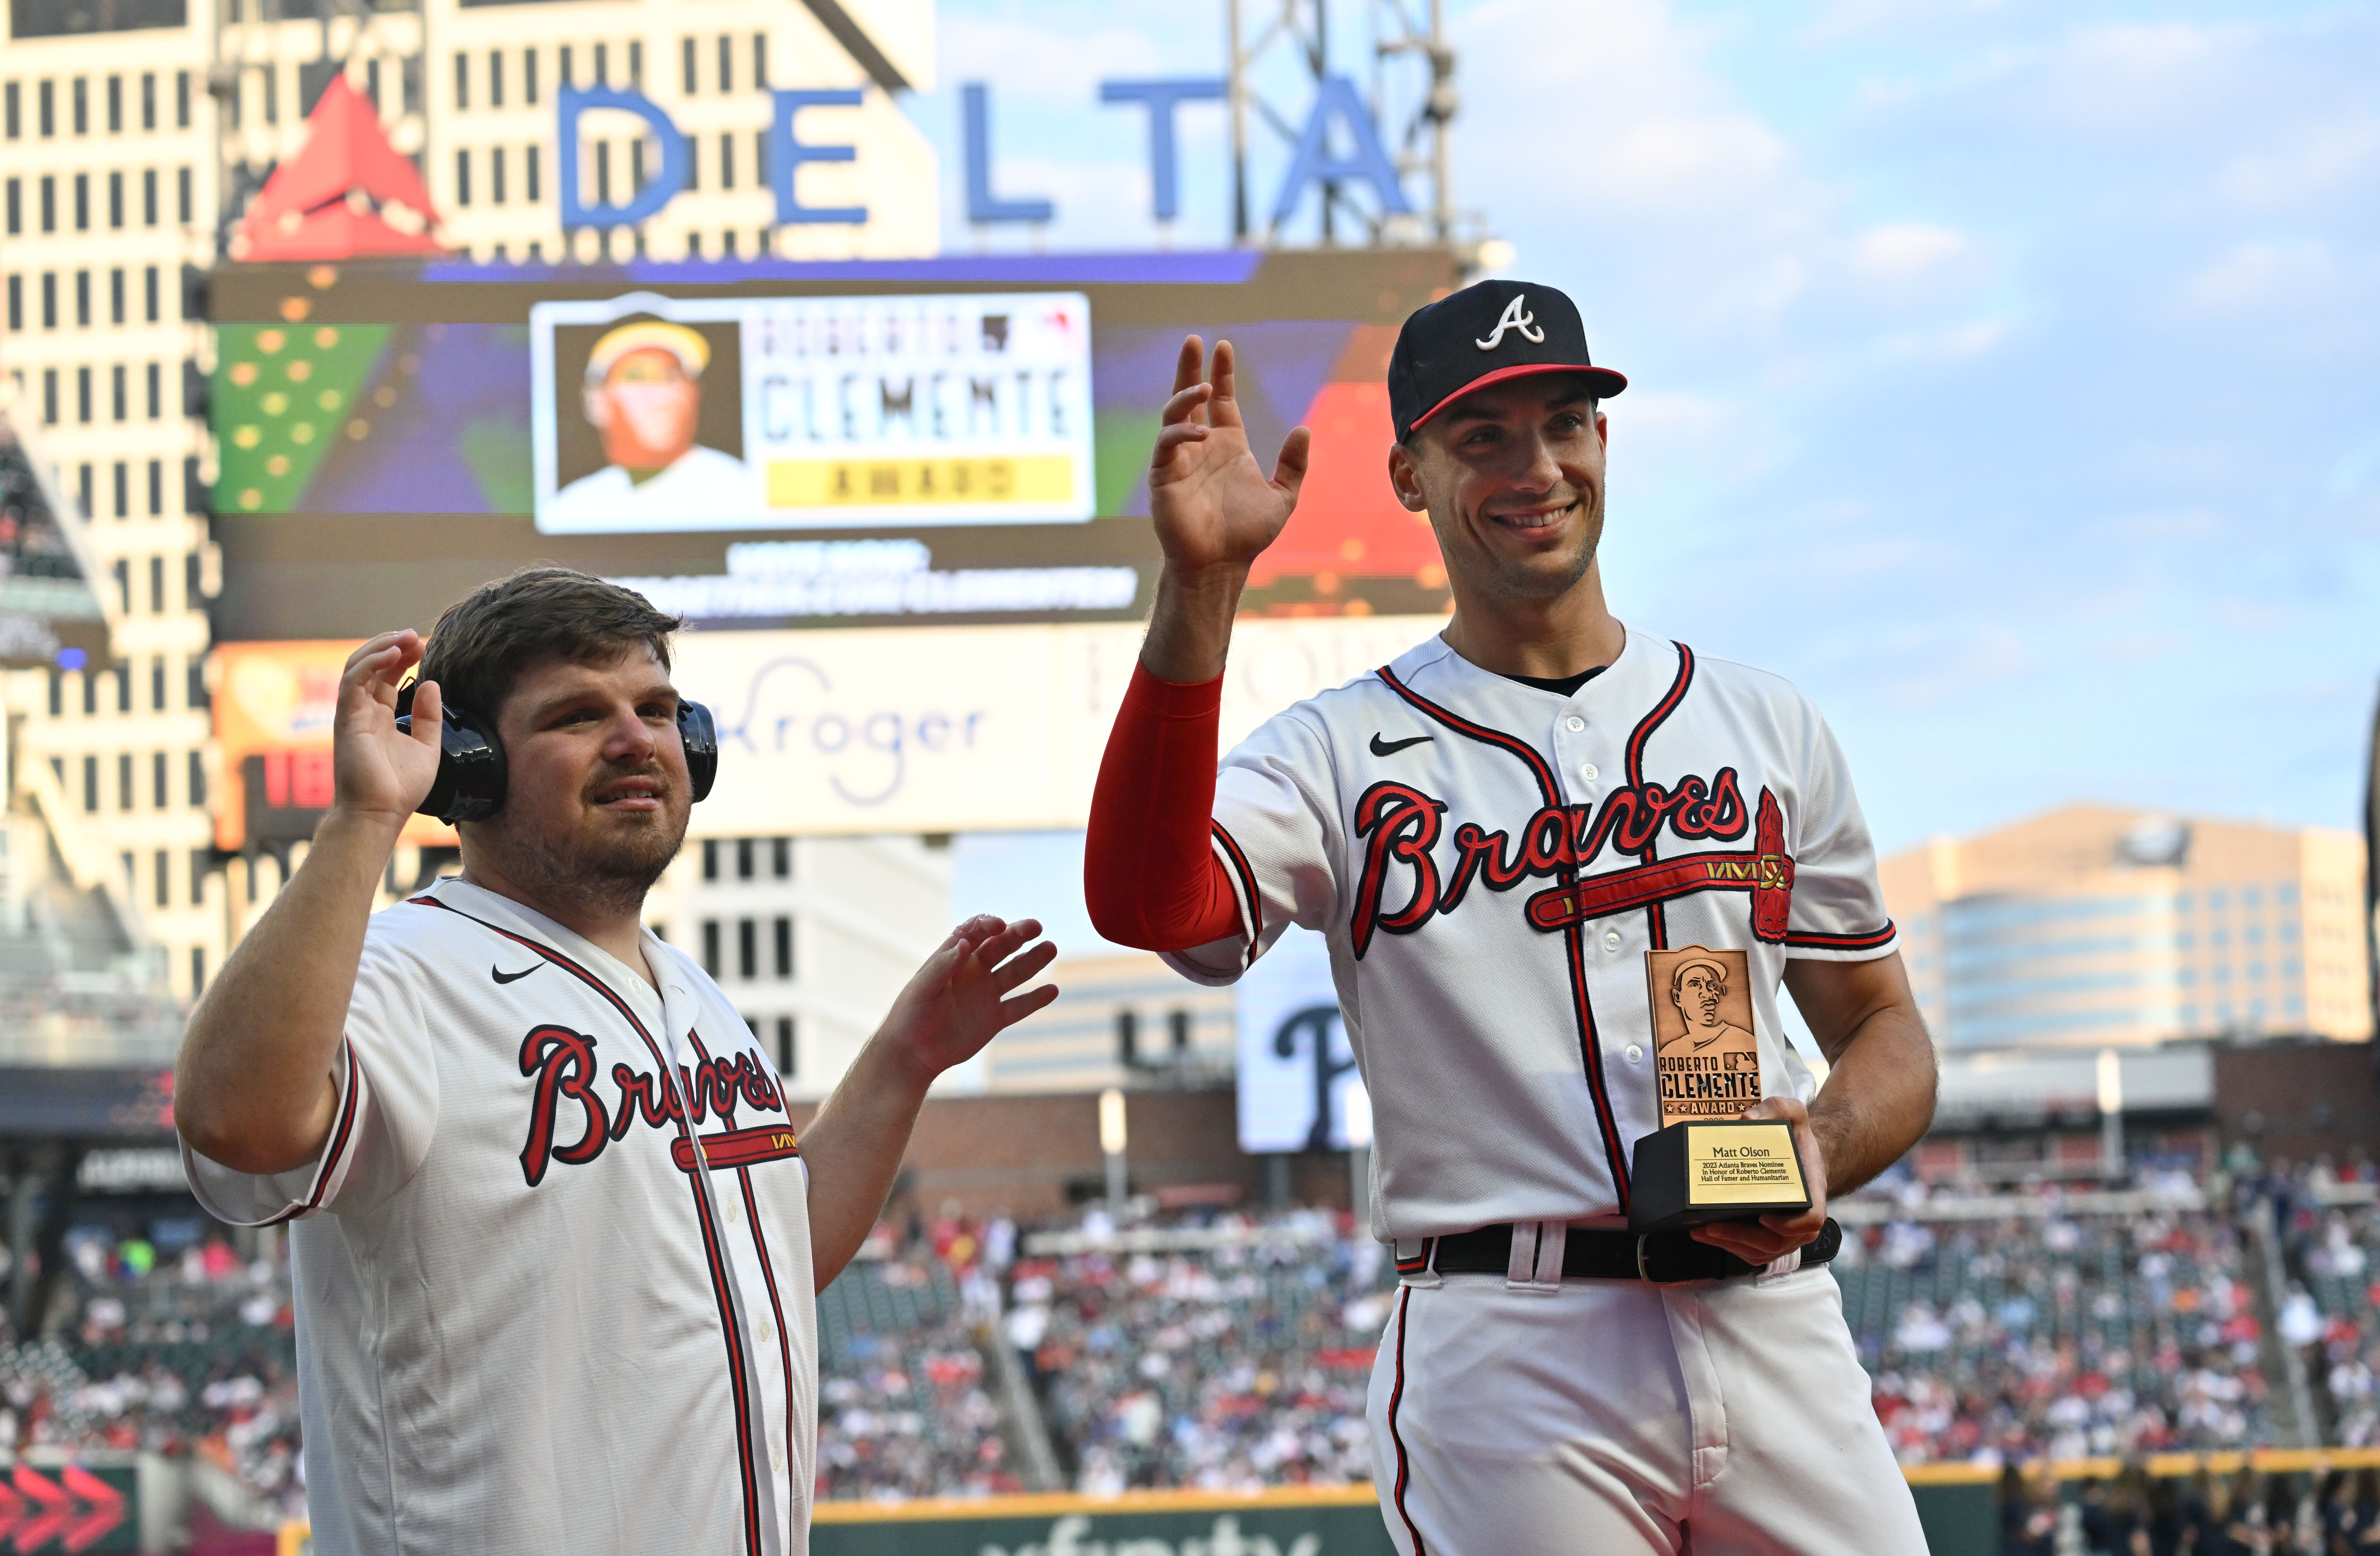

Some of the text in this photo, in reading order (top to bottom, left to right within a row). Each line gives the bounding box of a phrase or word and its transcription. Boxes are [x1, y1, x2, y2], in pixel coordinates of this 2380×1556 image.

[559, 79, 1412, 226] DELTA
[1476, 294, 1545, 351] A
[760, 369, 1072, 442] CLEMENTE
[1351, 767, 1746, 961] Braves
[1659, 1056, 1718, 1071] ROBERTO
[1661, 1072, 1760, 1099] CLEMENTE
[519, 1024, 781, 1187] Braves
[1691, 1102, 1734, 1114] AWARD
[1713, 1147, 1770, 1157] Matt Olson
